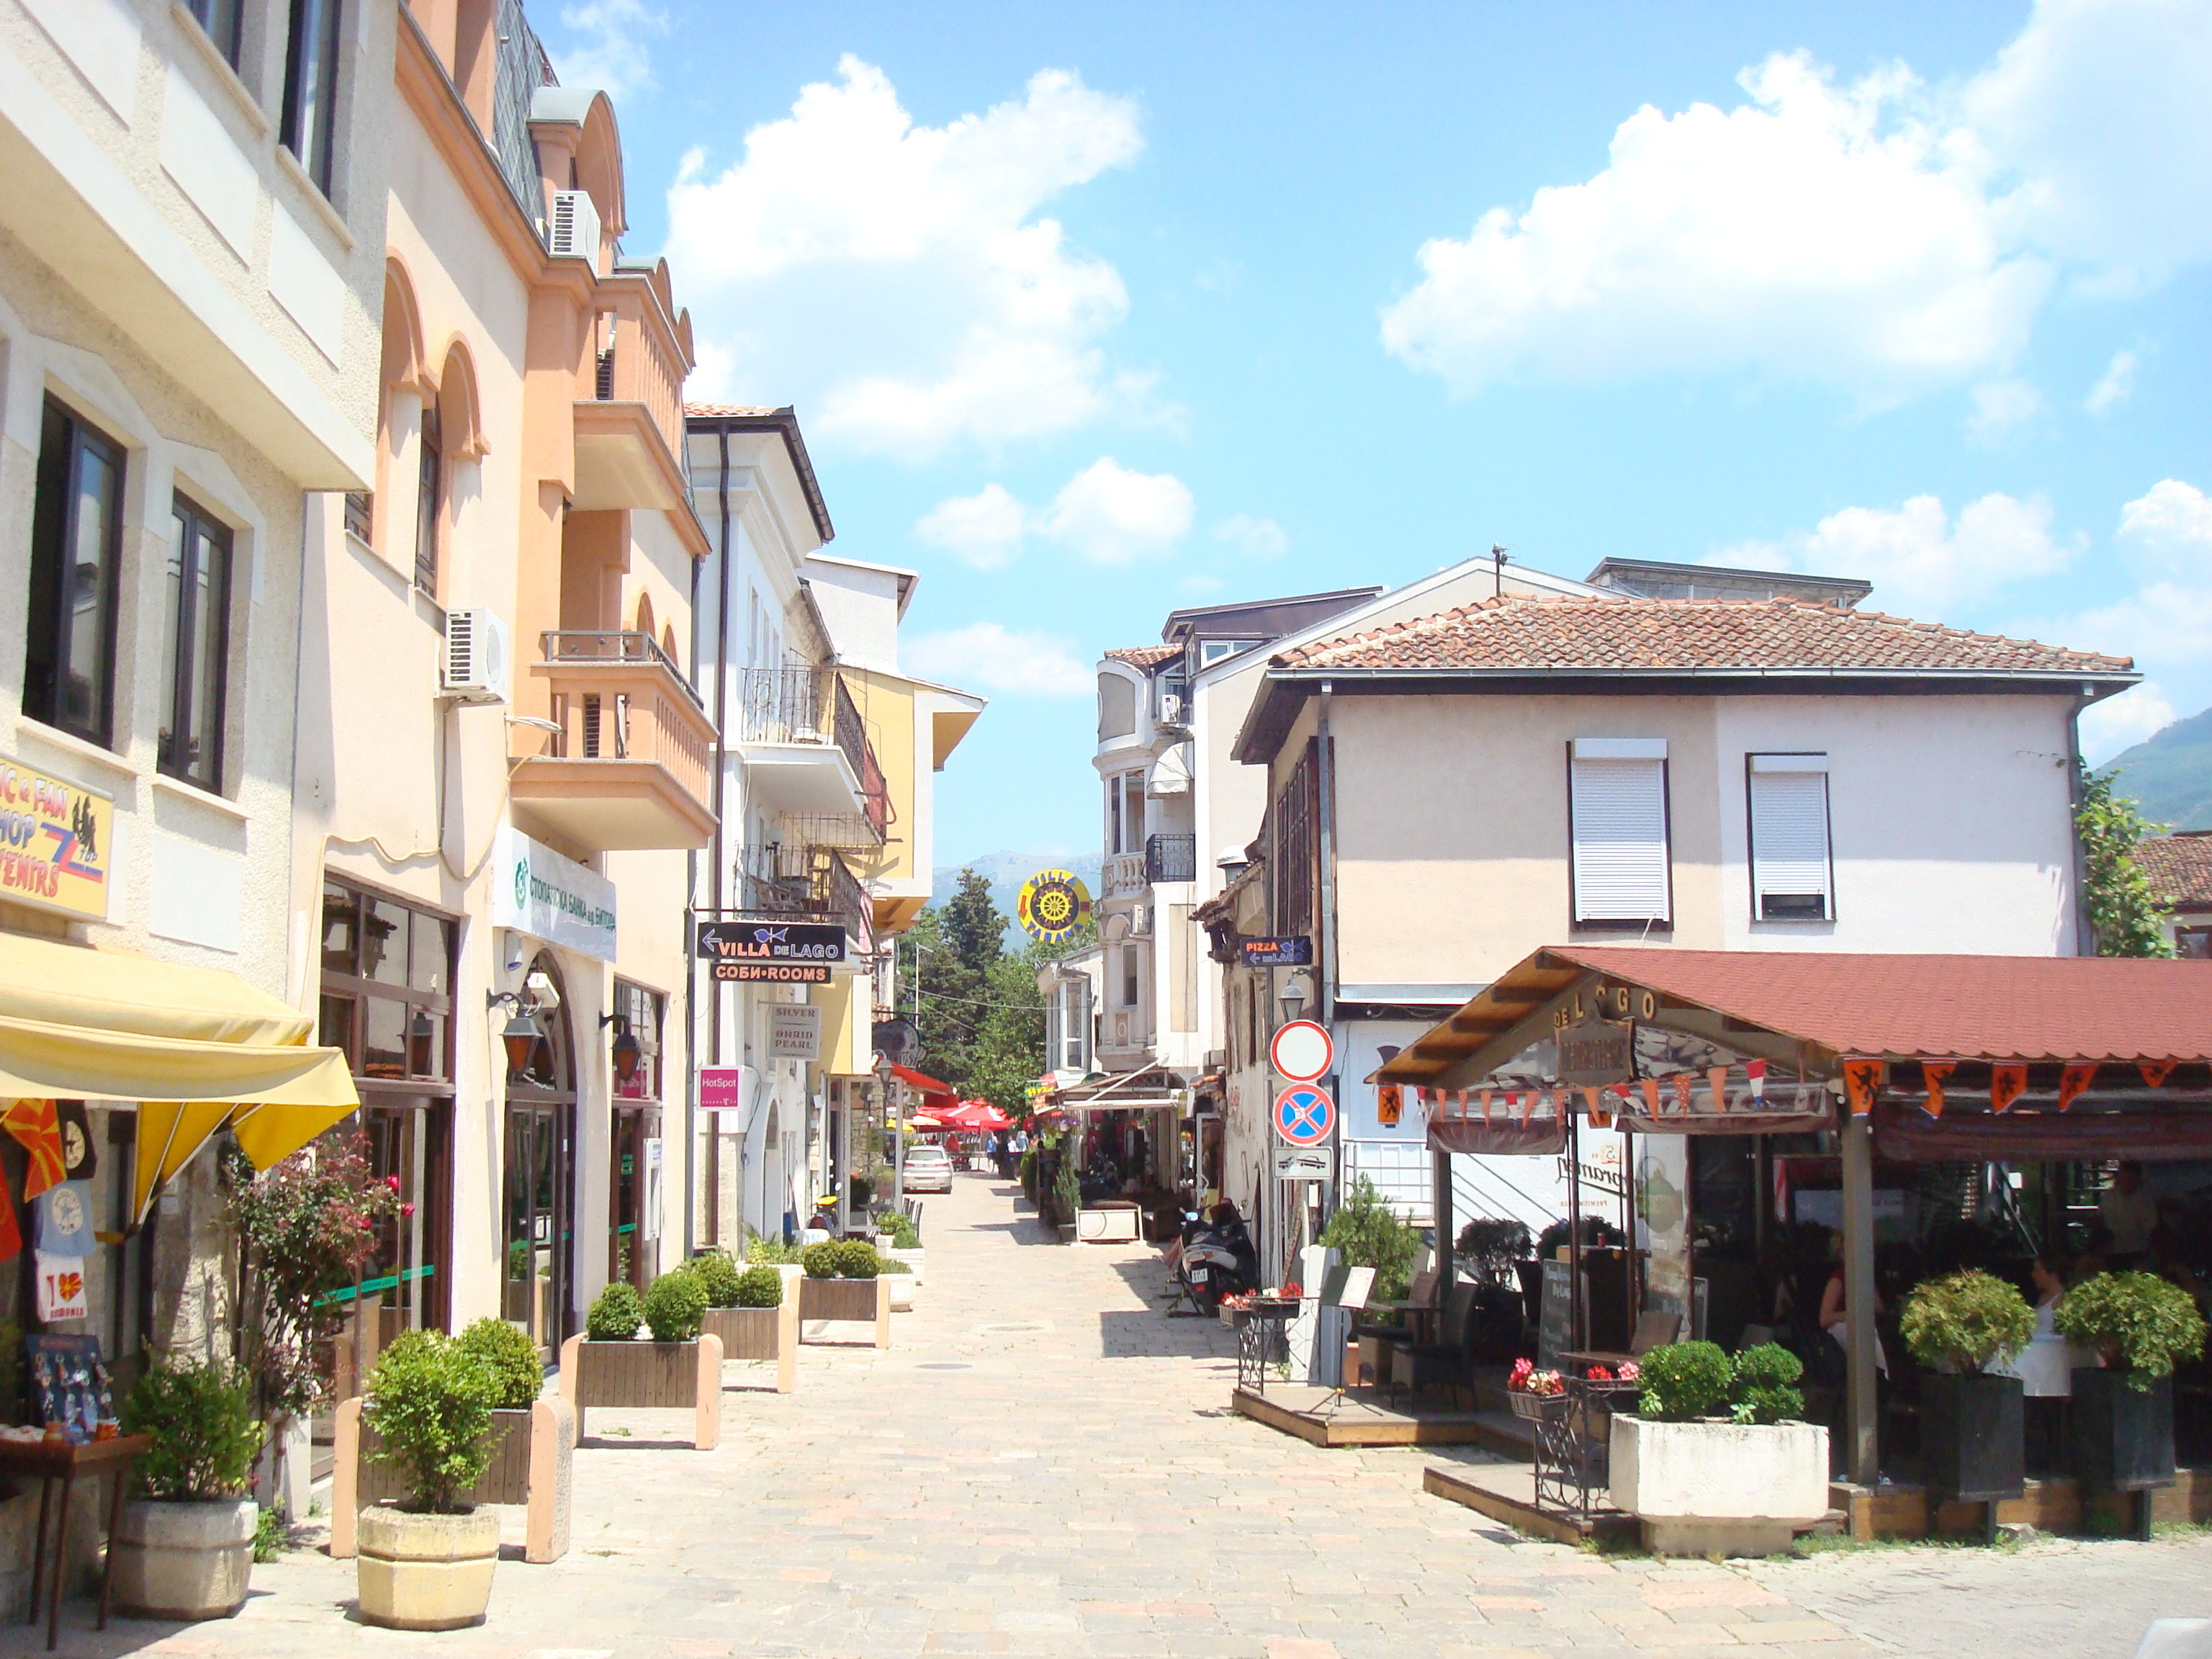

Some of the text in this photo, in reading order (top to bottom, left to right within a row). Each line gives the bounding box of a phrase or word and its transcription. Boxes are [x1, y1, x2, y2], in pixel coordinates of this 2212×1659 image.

[19, 777, 30, 804] &
[33, 777, 69, 821] FAN
[1030, 871, 1076, 887] VILLA
[719, 942, 839, 959] VILLA DE LAGO
[1246, 941, 1278, 952] PIZZA
[1272, 952, 1303, 963] LAGO
[767, 966, 826, 981] ROOMS
[775, 1008, 815, 1018] SILVER
[1554, 1007, 1569, 1028] DE
[775, 1030, 813, 1040] OHRID
[775, 1040, 813, 1050] PEARL
[702, 1077, 737, 1089] HotSpot
[45, 1274, 56, 1307] I
